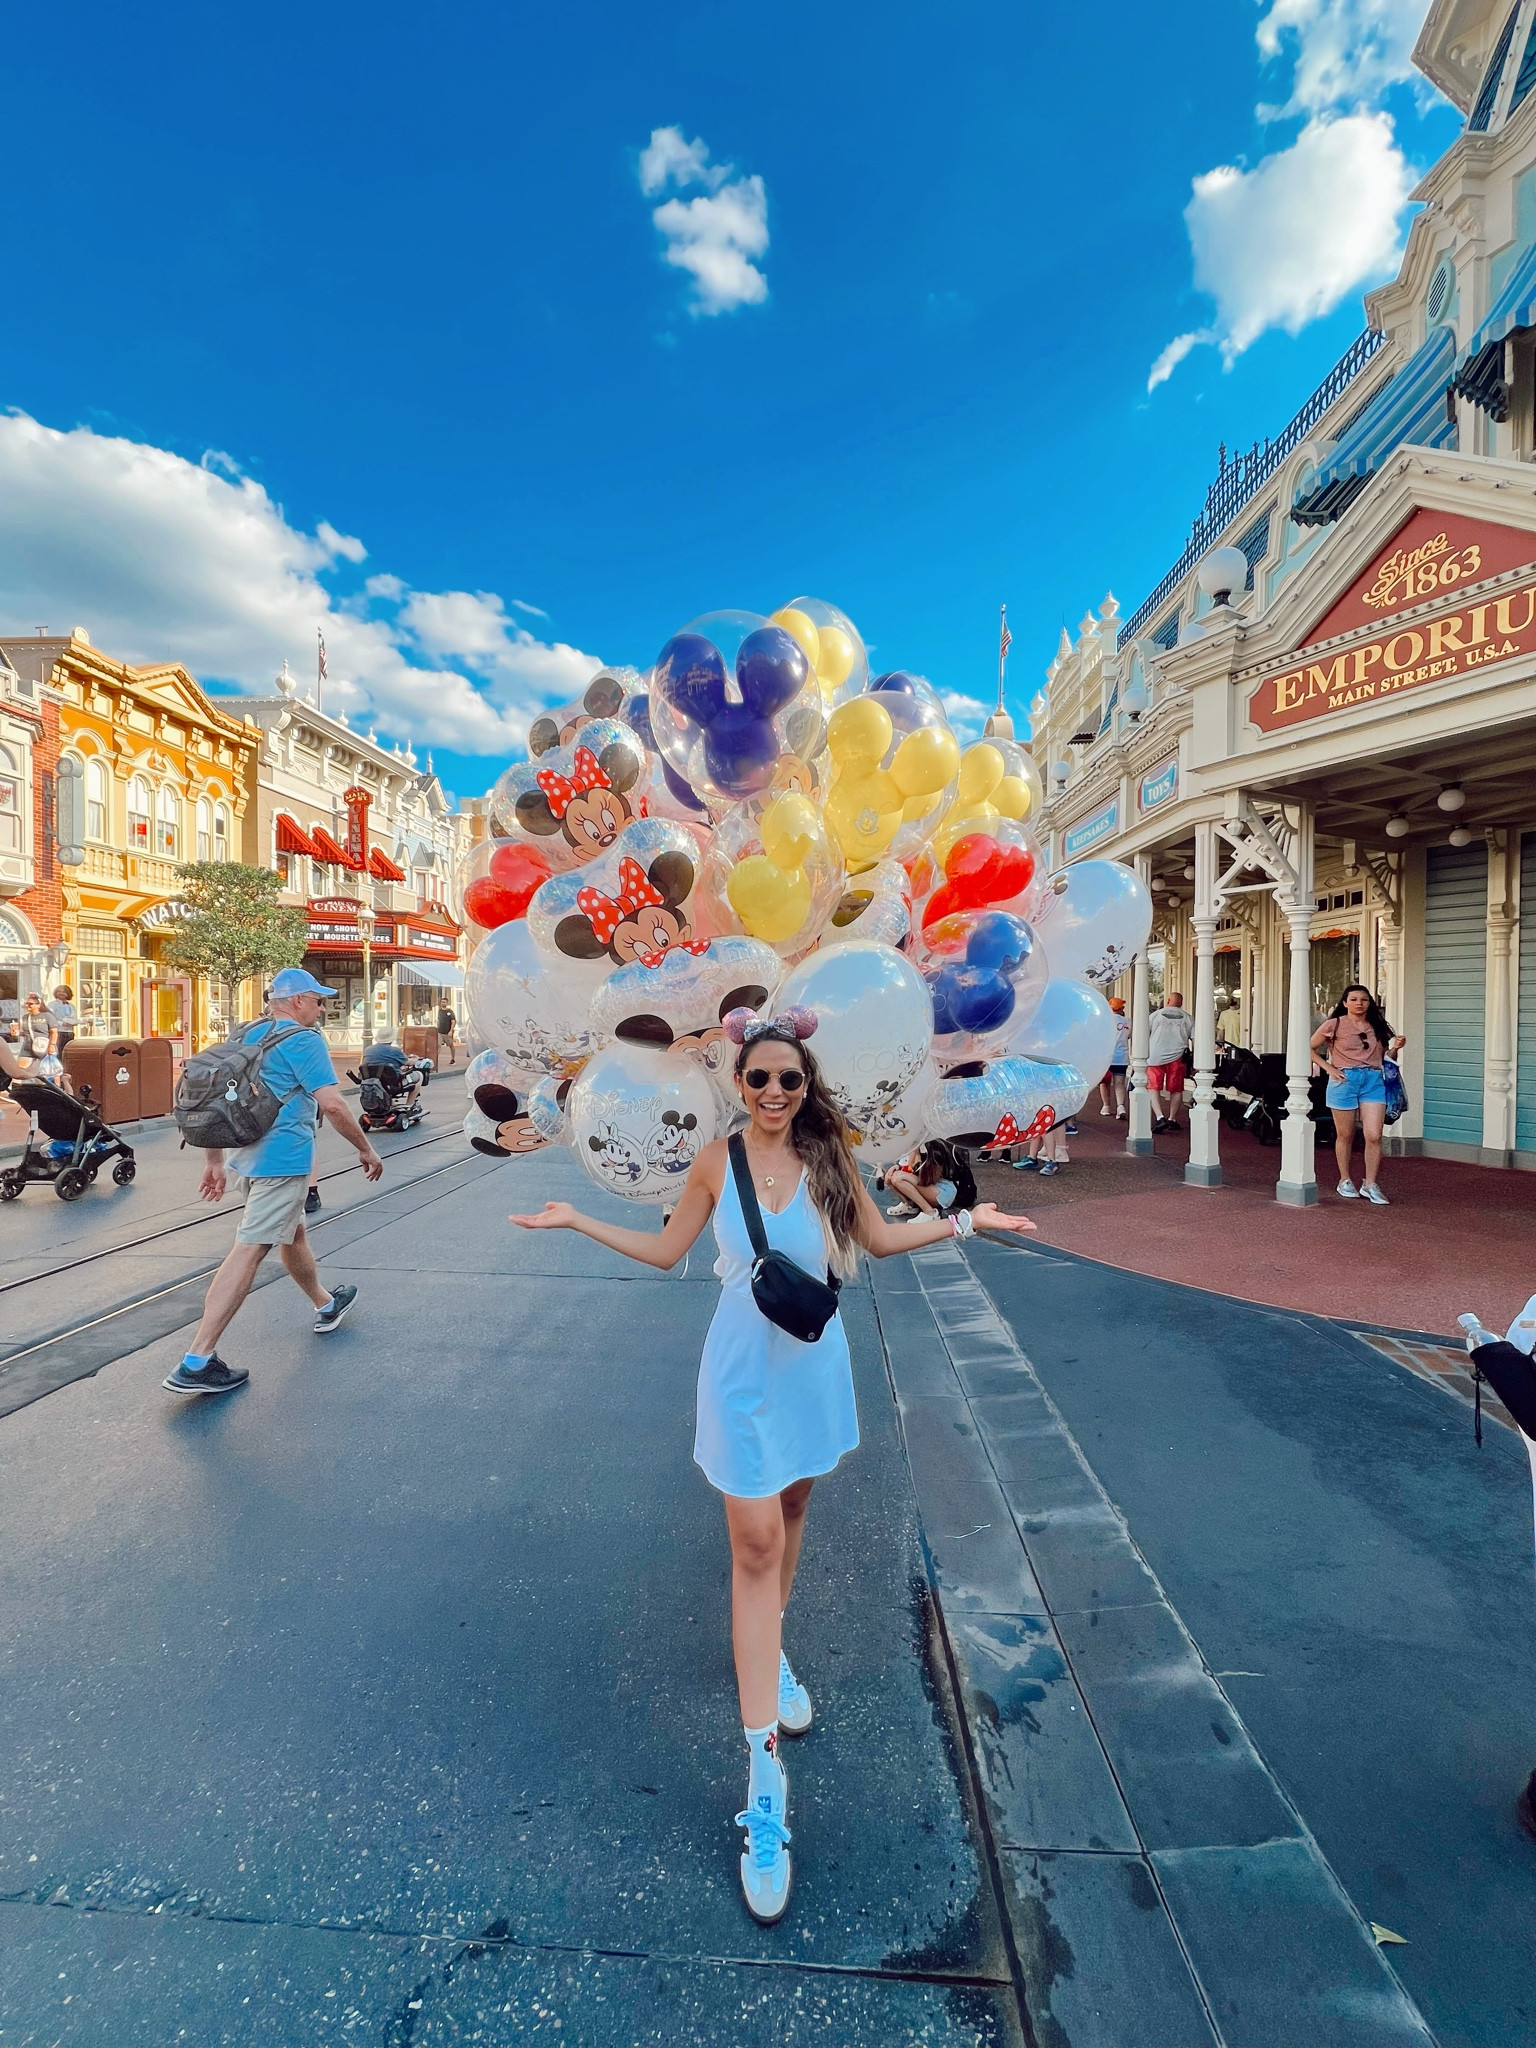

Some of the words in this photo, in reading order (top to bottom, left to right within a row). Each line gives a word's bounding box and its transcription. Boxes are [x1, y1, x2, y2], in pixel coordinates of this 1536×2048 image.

[1370, 532, 1450, 598] Since
[1401, 544, 1482, 601] 1863
[1327, 682, 1376, 709] MAIN
[1380, 656, 1459, 693] STREET,
[1465, 639, 1520, 666] U.S.A.
[345, 791, 366, 801] MAIN
[1147, 777, 1171, 802] TOYS
[350, 803, 363, 862] CINEMA
[1072, 816, 1110, 849] KEEPSAKES
[140, 901, 197, 930] WATC
[313, 902, 358, 913] CINEM
[310, 923, 330, 931] NOW
